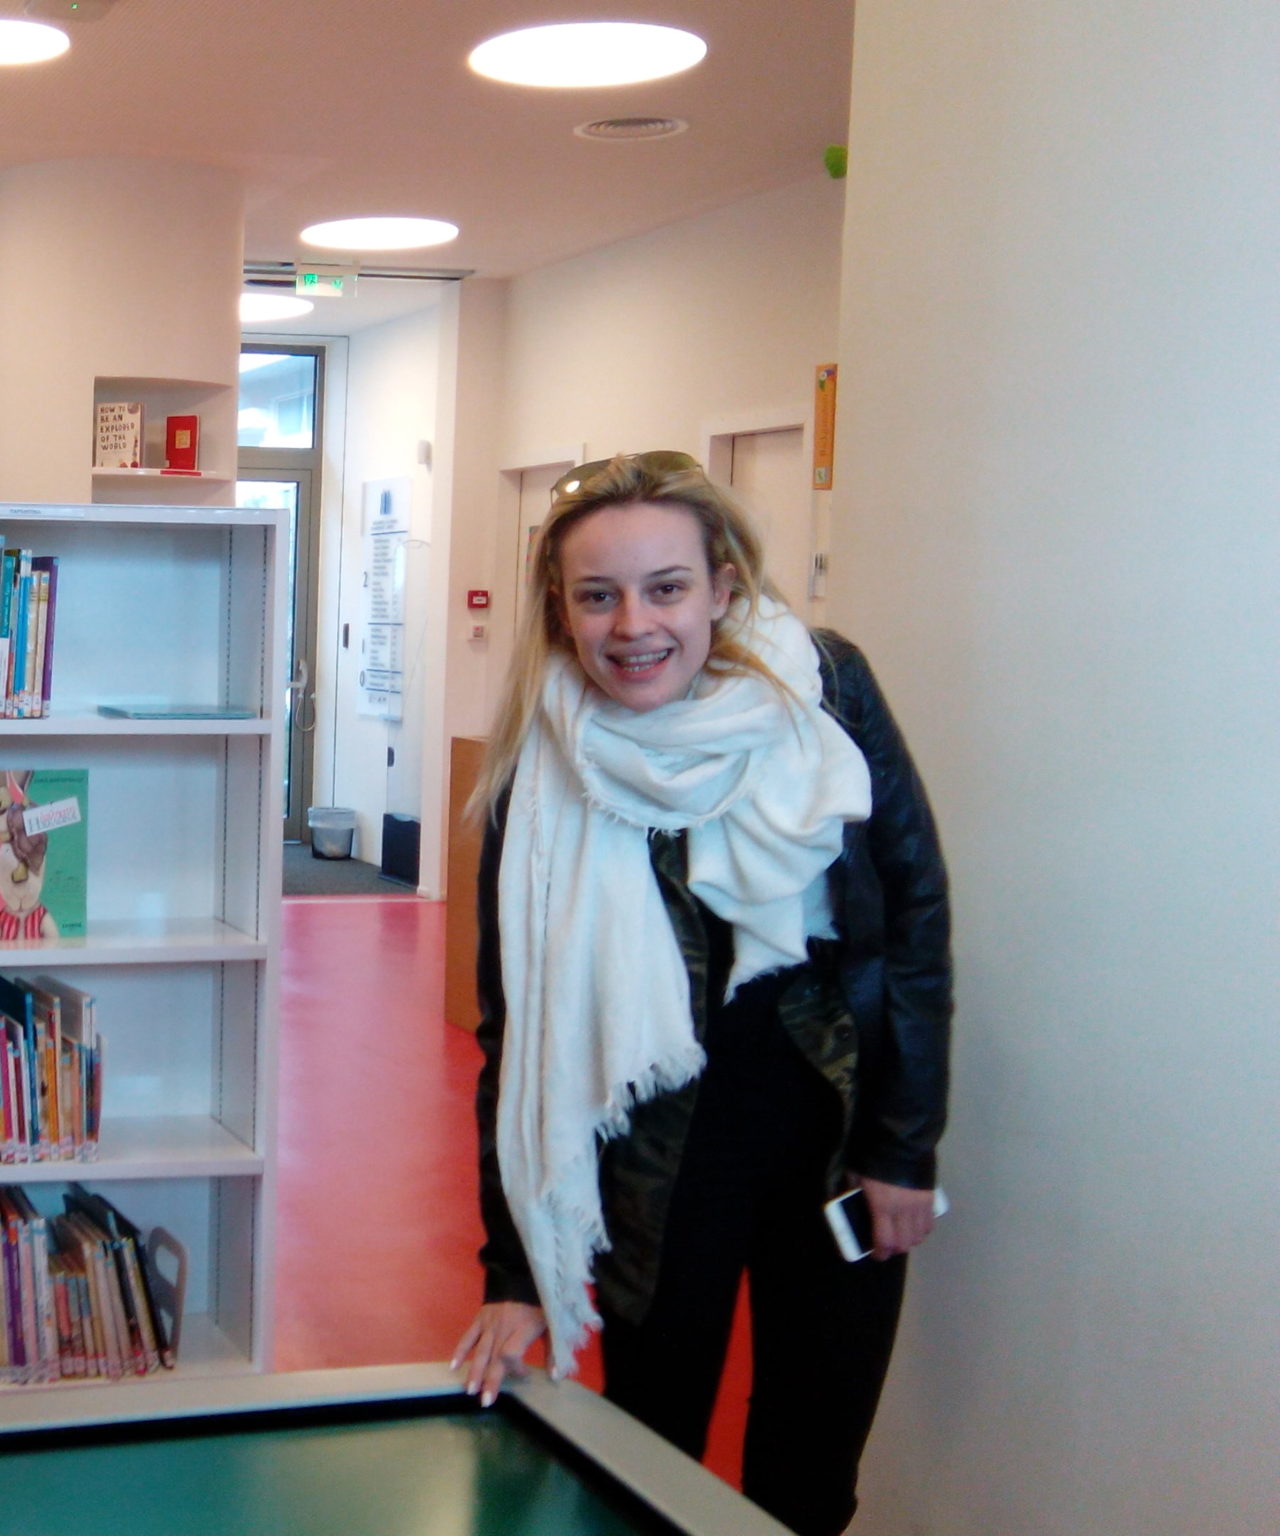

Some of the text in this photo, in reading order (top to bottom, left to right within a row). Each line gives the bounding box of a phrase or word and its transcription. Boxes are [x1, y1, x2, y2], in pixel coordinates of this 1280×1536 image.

[100, 414, 123, 423] BE AN
[101, 435, 109, 443] OF
[101, 442, 127, 450] WORLD
